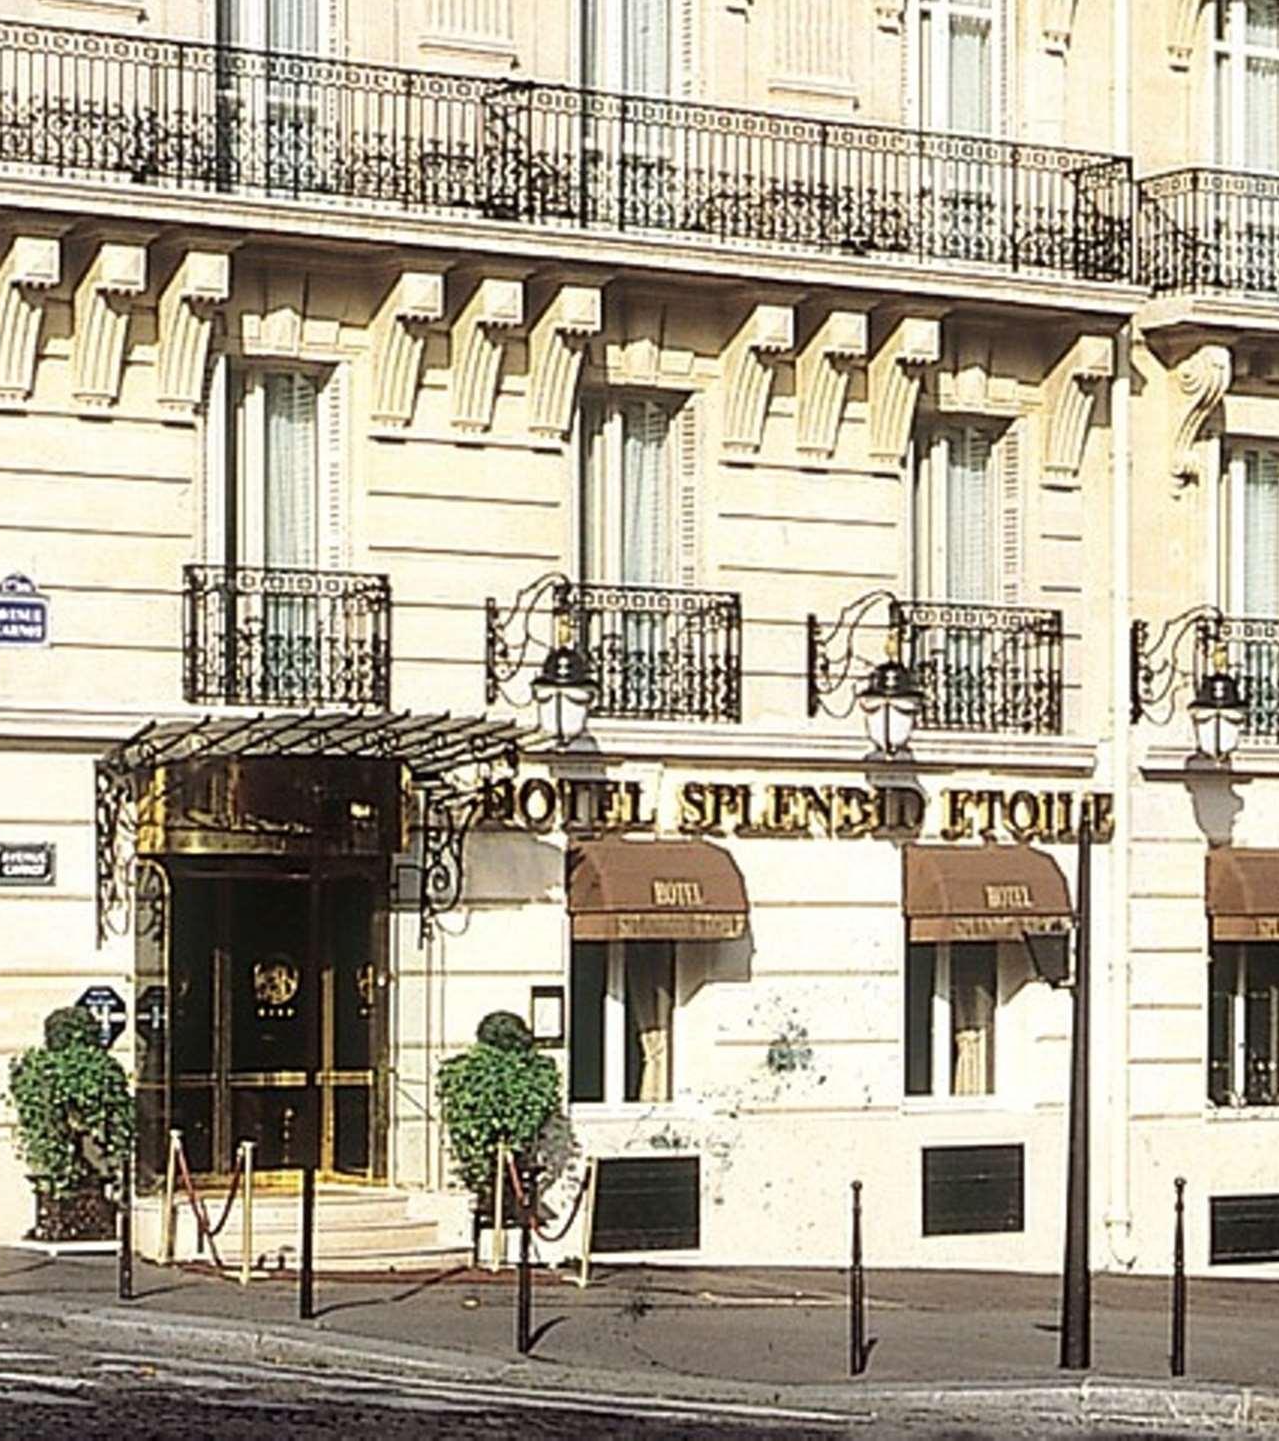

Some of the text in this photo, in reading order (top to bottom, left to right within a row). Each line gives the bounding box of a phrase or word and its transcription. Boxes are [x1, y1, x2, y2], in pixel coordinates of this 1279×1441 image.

[478, 777, 1116, 843] HOTEL SPLENDID ETOILE
[653, 880, 703, 906] HOTEL
[985, 885, 1032, 908] HOTEL
